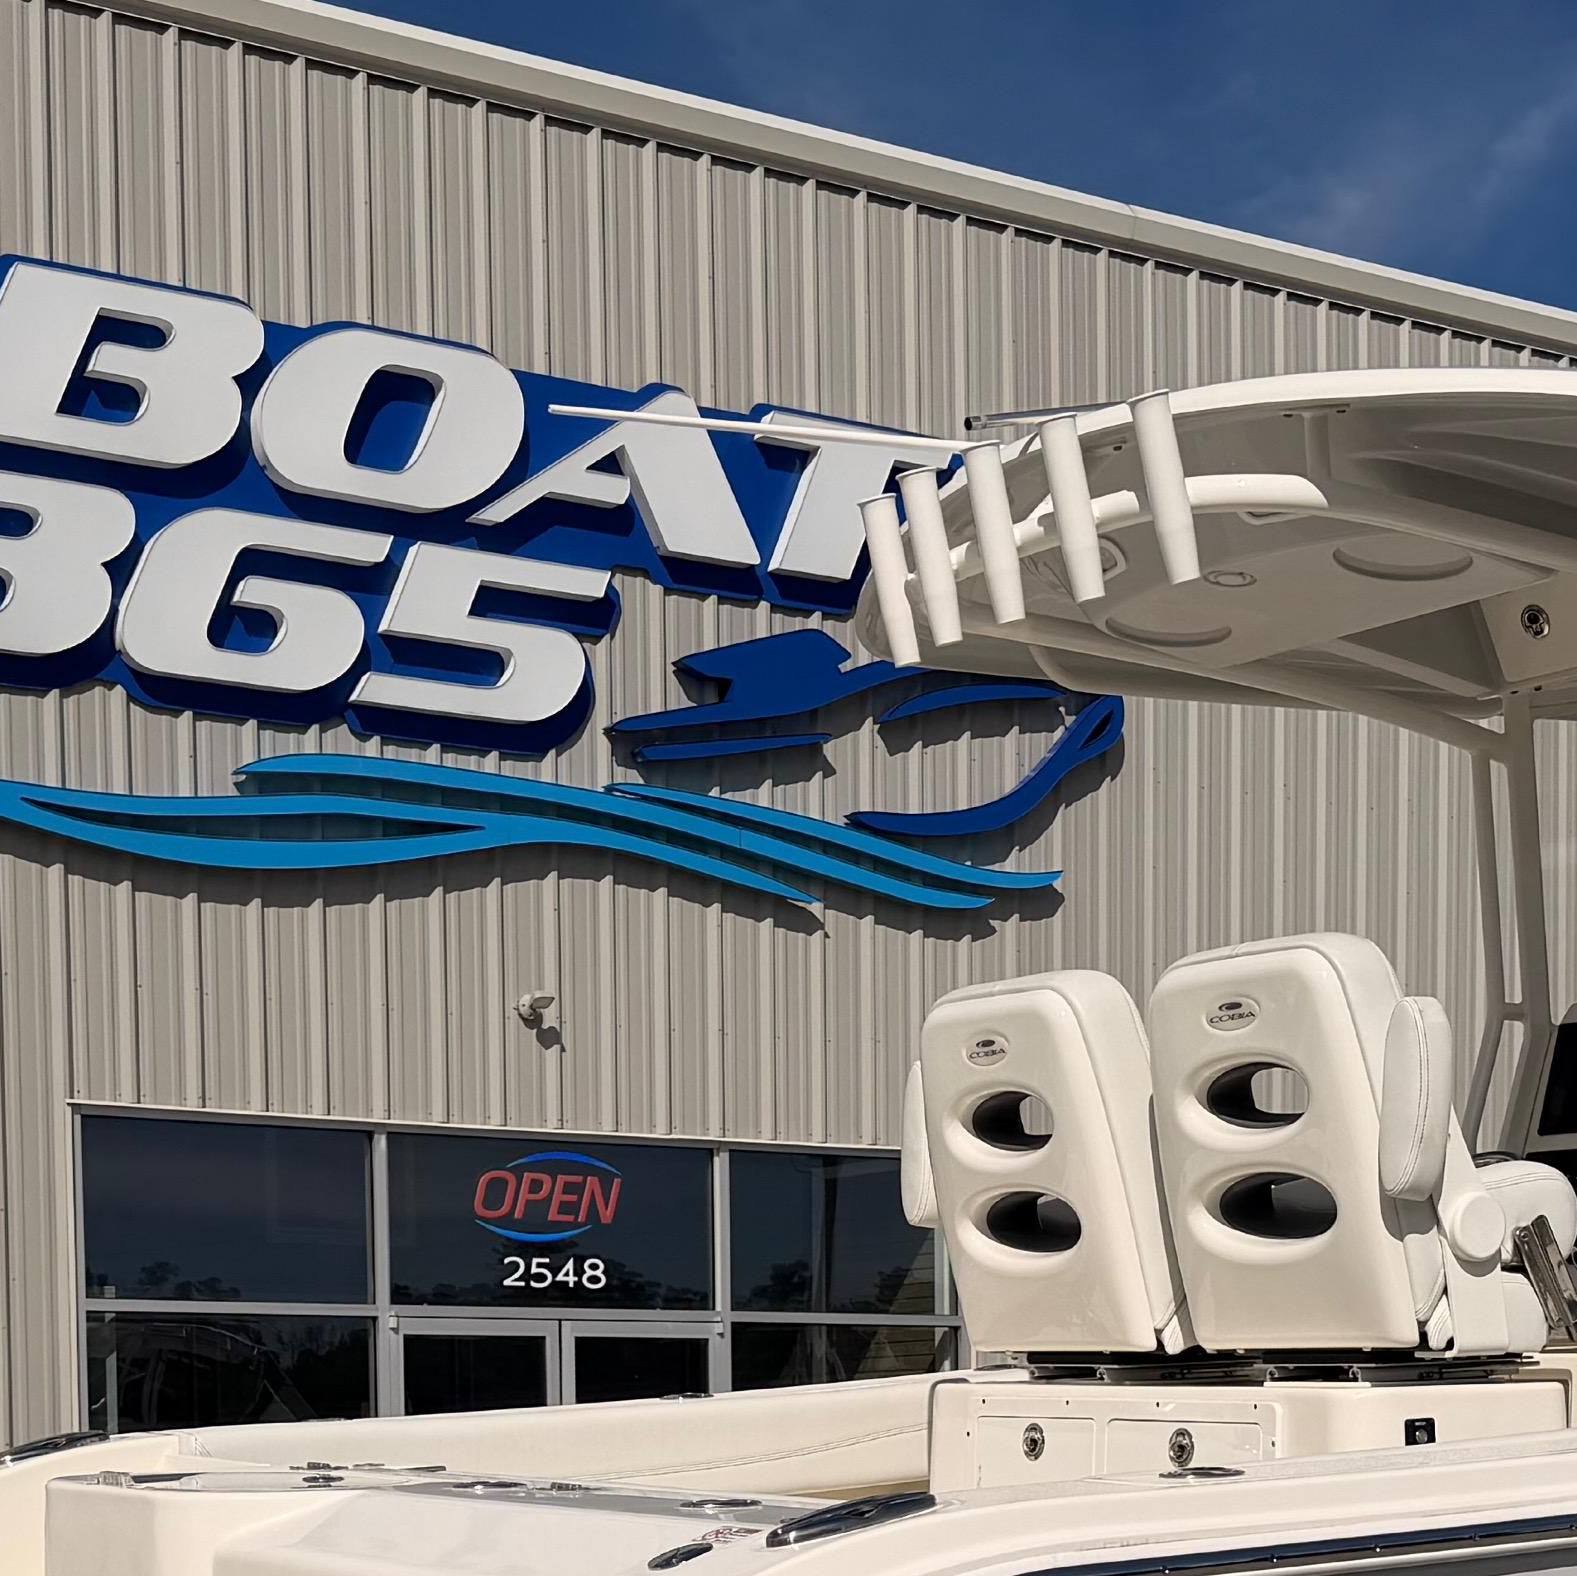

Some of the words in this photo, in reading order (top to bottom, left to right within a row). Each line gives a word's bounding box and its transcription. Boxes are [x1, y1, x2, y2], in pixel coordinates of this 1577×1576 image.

[1209, 1009, 1256, 1025] COBIA
[969, 1046, 1006, 1060] COBIA
[474, 1169, 622, 1224] OPEN
[502, 1256, 607, 1289] 2548
